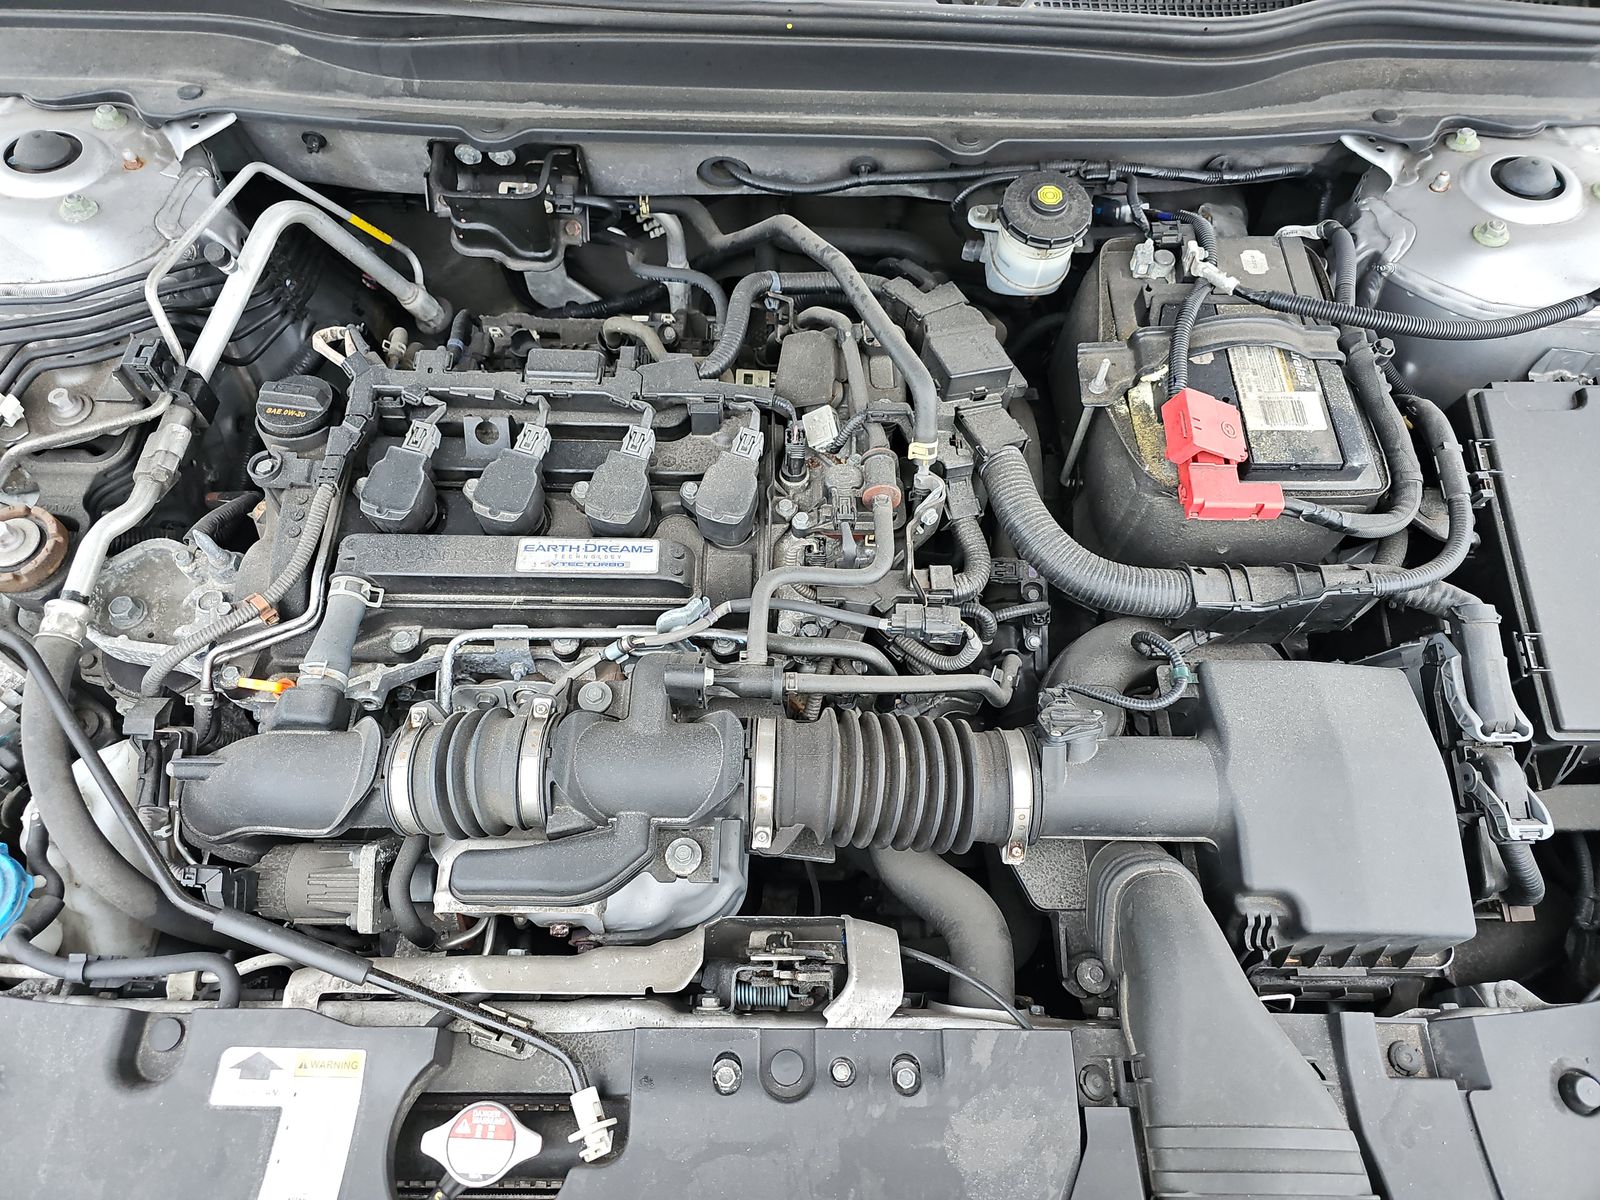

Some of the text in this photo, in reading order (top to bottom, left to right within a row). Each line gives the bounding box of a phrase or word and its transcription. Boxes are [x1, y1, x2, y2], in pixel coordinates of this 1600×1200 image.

[1290, 351, 1311, 387] uralast
[523, 543, 653, 554] EARTH DREAMS
[310, 1060, 359, 1070] WARNING
